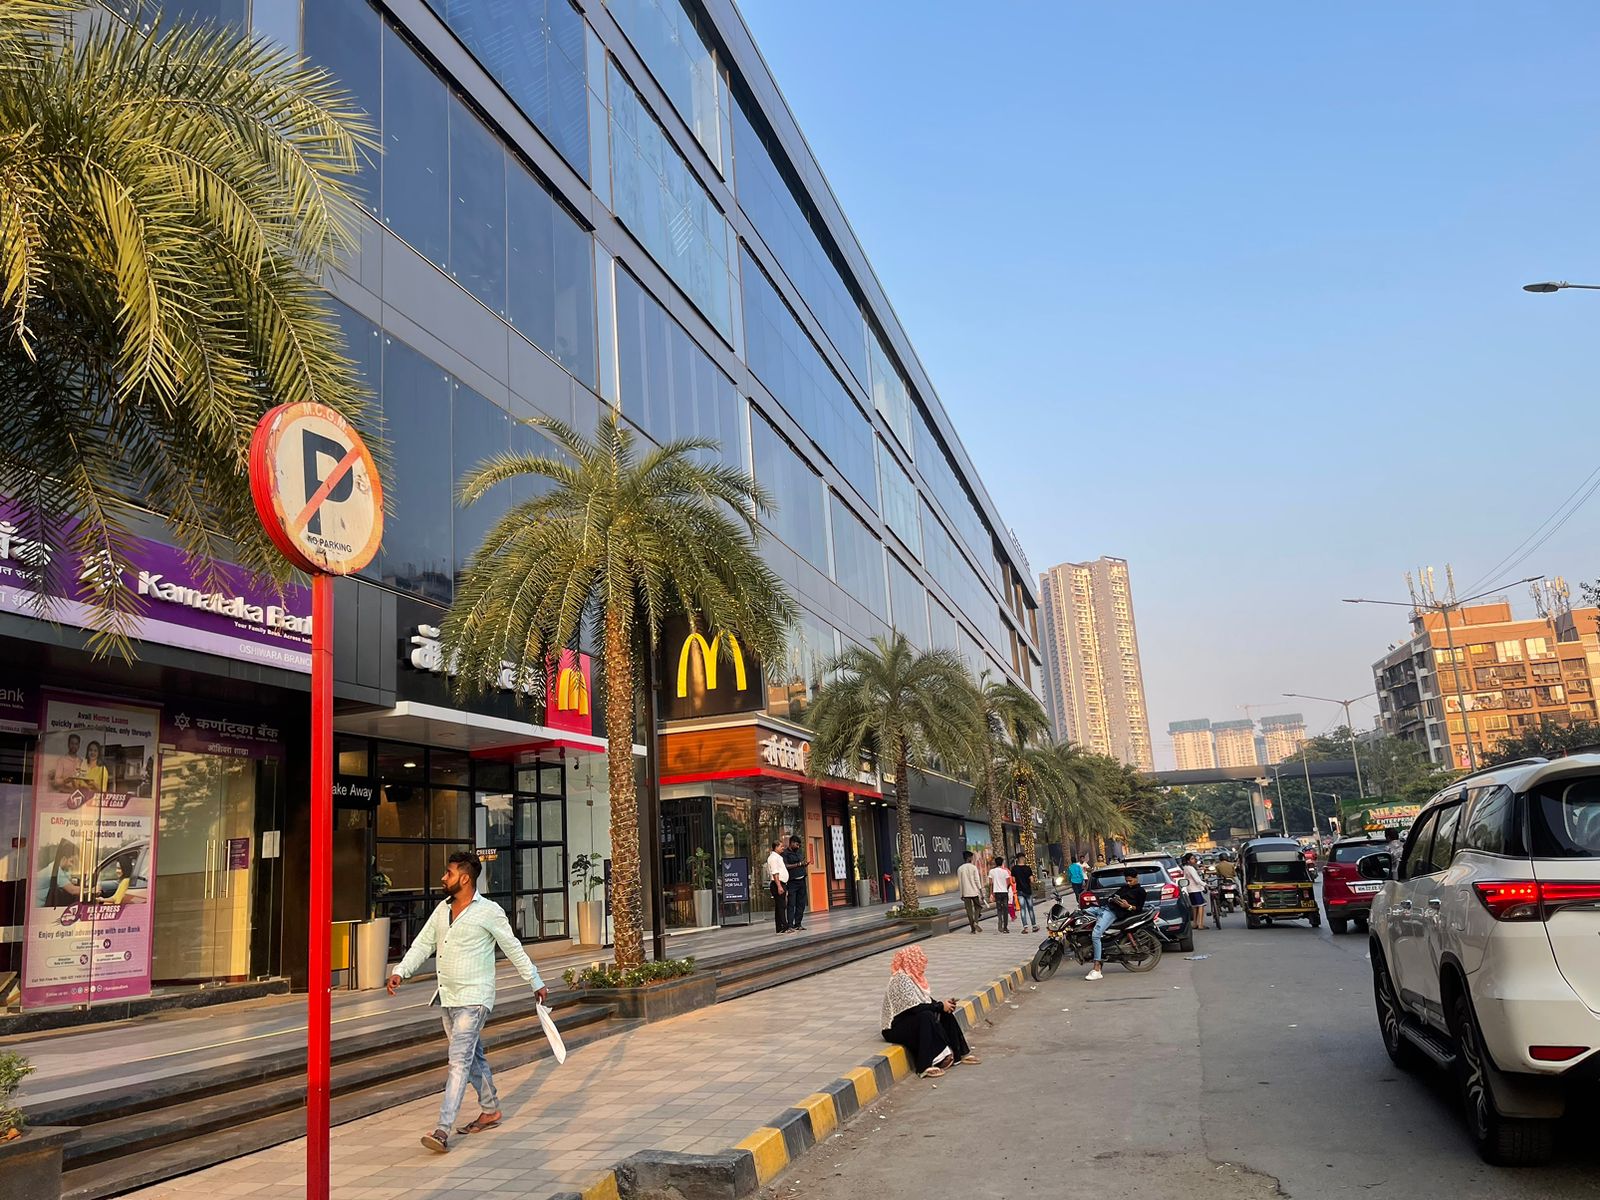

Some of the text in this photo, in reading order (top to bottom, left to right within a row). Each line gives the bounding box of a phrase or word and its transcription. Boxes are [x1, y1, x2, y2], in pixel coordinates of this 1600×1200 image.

[307, 535, 352, 552] NO PARKING
[138, 570, 264, 623] Karnataka
[234, 621, 247, 629] Your
[248, 624, 266, 634] Family
[283, 634, 301, 642] Across
[239, 643, 312, 667] OSHIWARA BRANC
[0, 688, 24, 703] ank
[51, 719, 72, 729] quickly
[119, 727, 130, 736] only
[131, 728, 152, 738] through
[332, 782, 372, 801] ake Away
[50, 816, 79, 827] CARrying
[116, 830, 123, 838] of
[932, 836, 952, 853] OPENING
[937, 858, 951, 875] SOON
[99, 905, 121, 913] XPRESS
[100, 912, 116, 920] LOAN
[38, 930, 54, 940] Enjoy
[55, 929, 74, 938] digital
[105, 927, 117, 935] with
